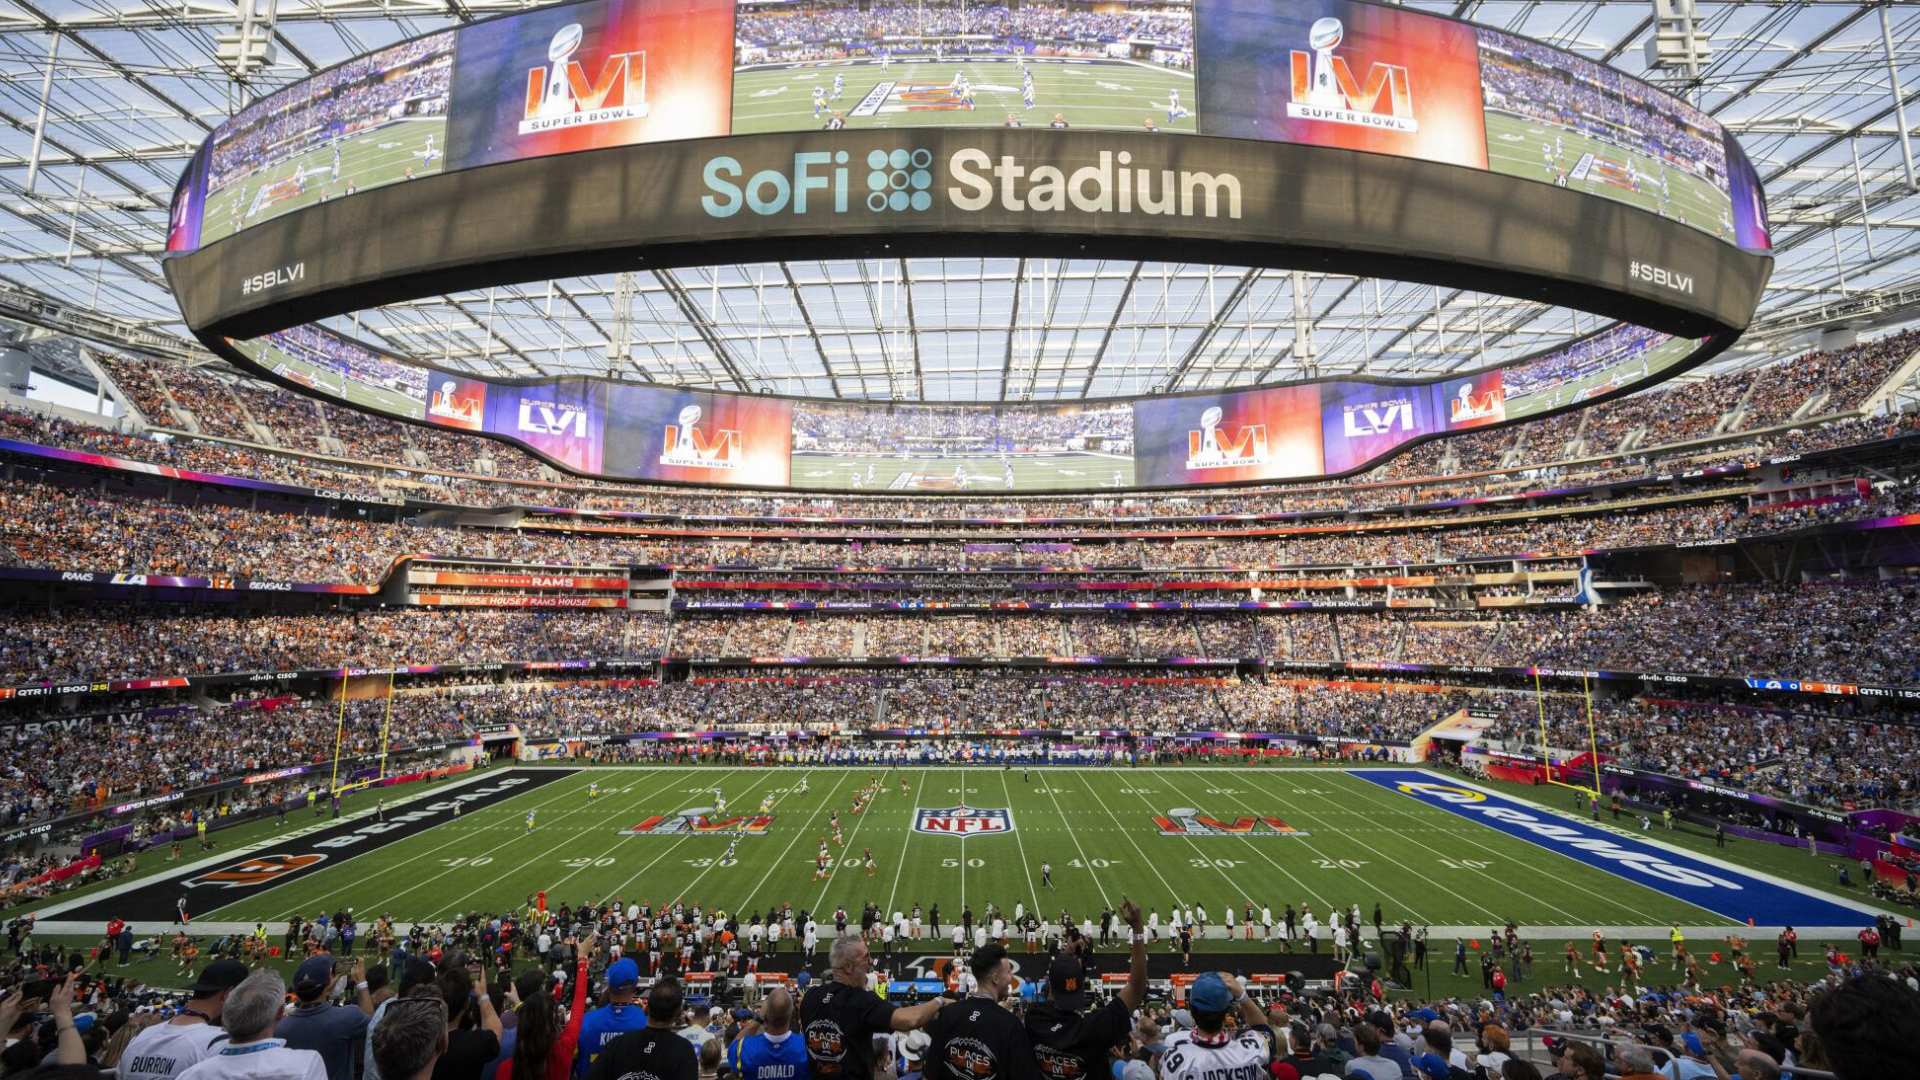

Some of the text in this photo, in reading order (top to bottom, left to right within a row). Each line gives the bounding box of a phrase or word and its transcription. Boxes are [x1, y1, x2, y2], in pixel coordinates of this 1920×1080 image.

[531, 109, 634, 130] SUPER BOWL
[1301, 107, 1404, 129] SUPER BOWL
[702, 149, 1242, 218] SoFi Stadium
[243, 263, 304, 295] #SBLVI
[1630, 261, 1692, 293] #SBLVI
[521, 399, 585, 412] SUPER BOWL
[1344, 398, 1411, 412] SUPER BOWL
[518, 405, 586, 437] LVI
[1344, 403, 1413, 437] LVI
[1771, 454, 1801, 464] BENGALS
[315, 490, 405, 506] LOS ANGELES
[1695, 538, 1737, 546] ANGELES
[62, 572, 94, 581] RAMS
[249, 582, 291, 590] BENGALS
[532, 577, 574, 587] RAMS
[452, 596, 486, 605] WHOSE
[490, 597, 528, 605] HOUSE?
[558, 597, 590, 606] HOUSE!
[1664, 675, 1687, 683] CISCO
[18, 688, 43, 697] QTR
[57, 685, 88, 694] 15:00
[93, 683, 108, 691] 25
[249, 767, 302, 783] LOS ANGELES
[1690, 782, 1715, 793] SUPER
[1716, 787, 1738, 797] BOWL
[117, 792, 184, 814] SUPER BOWL LVI
[313, 778, 530, 848] BENGALS
[30, 824, 52, 835] CISCO
[924, 818, 1008, 832] NFL
[1460, 804, 1744, 890] RAMS
[443, 857, 494, 867] 10
[565, 857, 616, 867] 20
[692, 858, 738, 868] 30
[941, 858, 985, 868] 50
[1067, 858, 1110, 868] 40
[1189, 858, 1236, 869] 30
[1311, 858, 1362, 869] 20
[1437, 858, 1487, 870] 10
[809, 1031, 841, 1043] PLACES
[950, 1046, 990, 1066] PLACES
[1036, 1052, 1079, 1068] PLACES
[1161, 1039, 1184, 1074] 39
[131, 1056, 176, 1075] BURROW
[758, 1064, 795, 1080] DONALD
[1203, 1064, 1257, 1080] JACKSON
